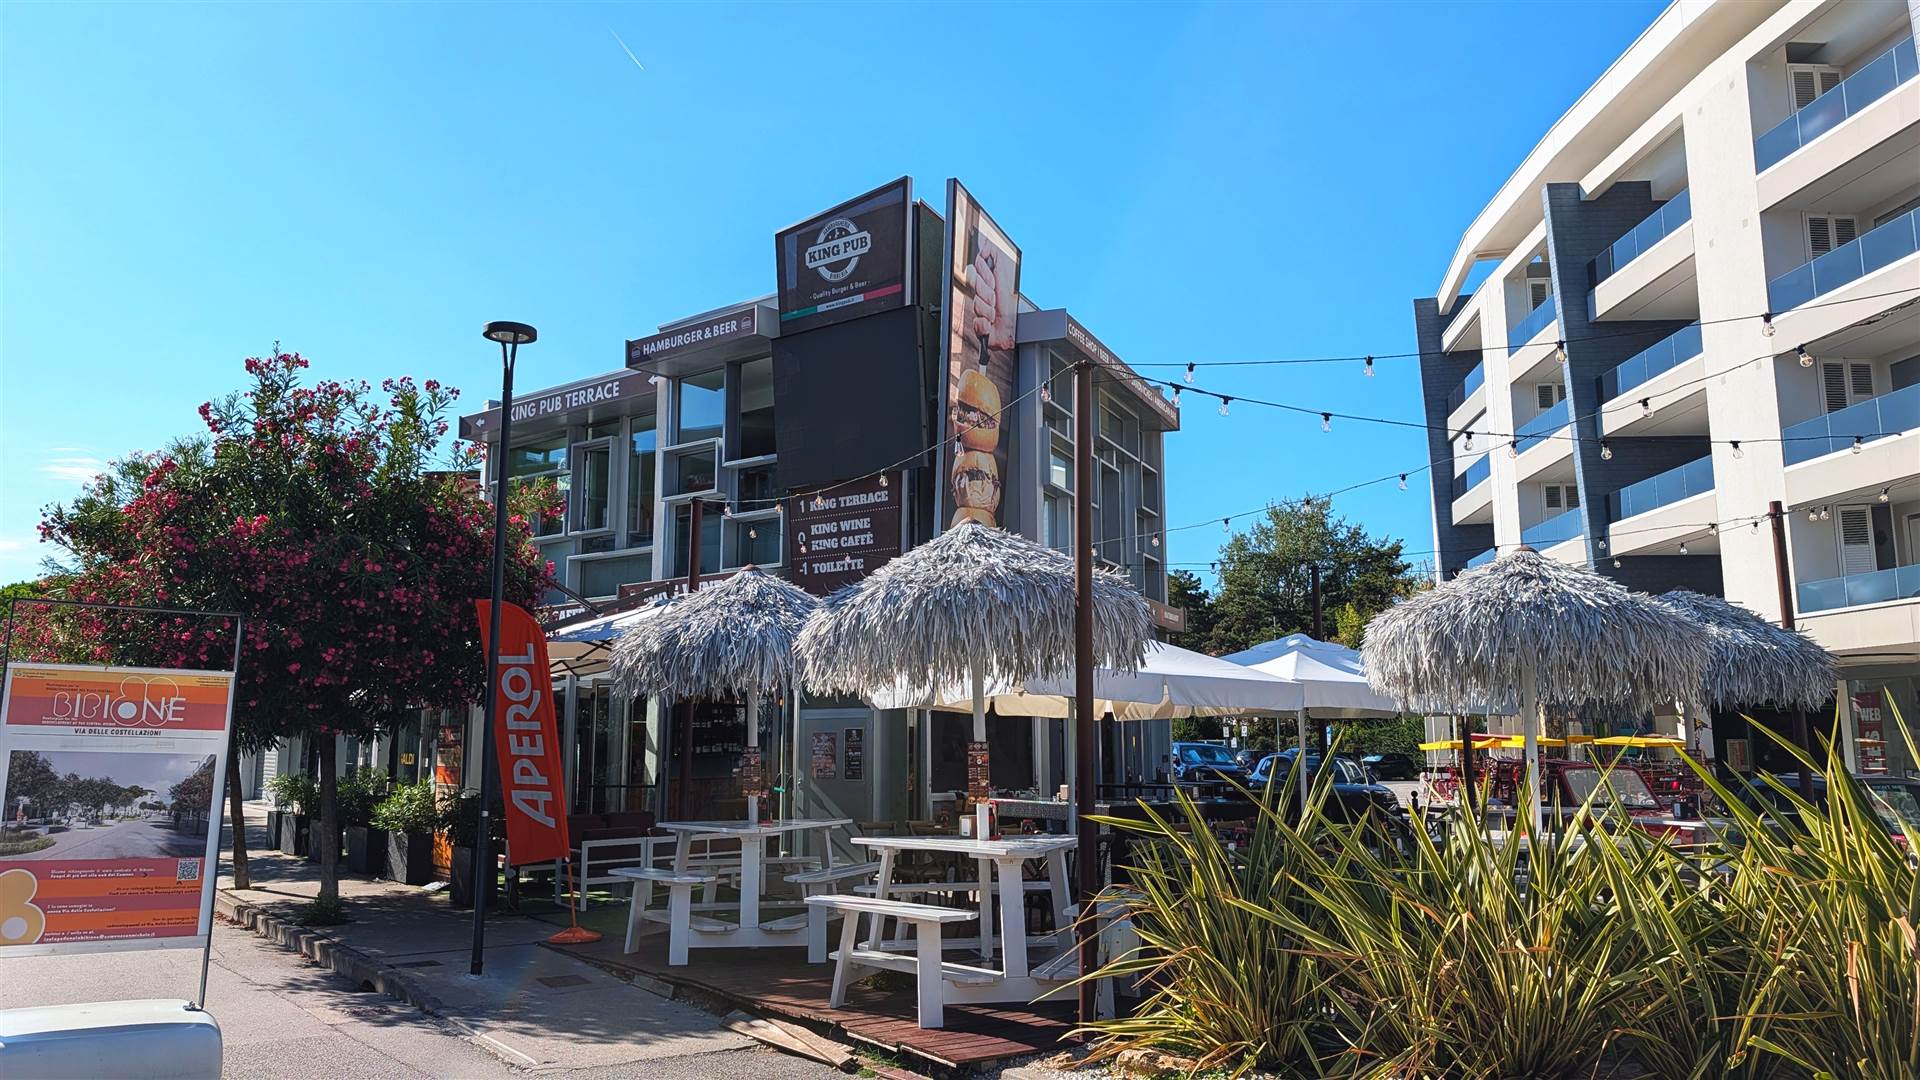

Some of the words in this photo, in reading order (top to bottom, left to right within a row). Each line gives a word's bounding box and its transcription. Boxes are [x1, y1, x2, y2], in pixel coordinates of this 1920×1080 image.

[808, 244, 840, 264] KING
[843, 236, 868, 254] PUB
[643, 329, 703, 356] HAMBURGER
[713, 320, 737, 338] BEER
[1068, 323, 1085, 345] COFFEE
[1085, 336, 1098, 354] SHOP
[510, 402, 536, 422] KING
[539, 397, 562, 416] PUB
[565, 381, 620, 409] TERRACE
[800, 500, 805, 513] 1
[809, 498, 837, 512] KING
[838, 491, 888, 507] TERRACE
[810, 522, 838, 535] KING
[840, 517, 871, 532] WINE
[811, 538, 838, 551] KING
[812, 558, 864, 574] TOILETTE
[53, 683, 186, 725] BIBIONE
[1860, 707, 1881, 721] WEB
[498, 643, 556, 829] APEROL
